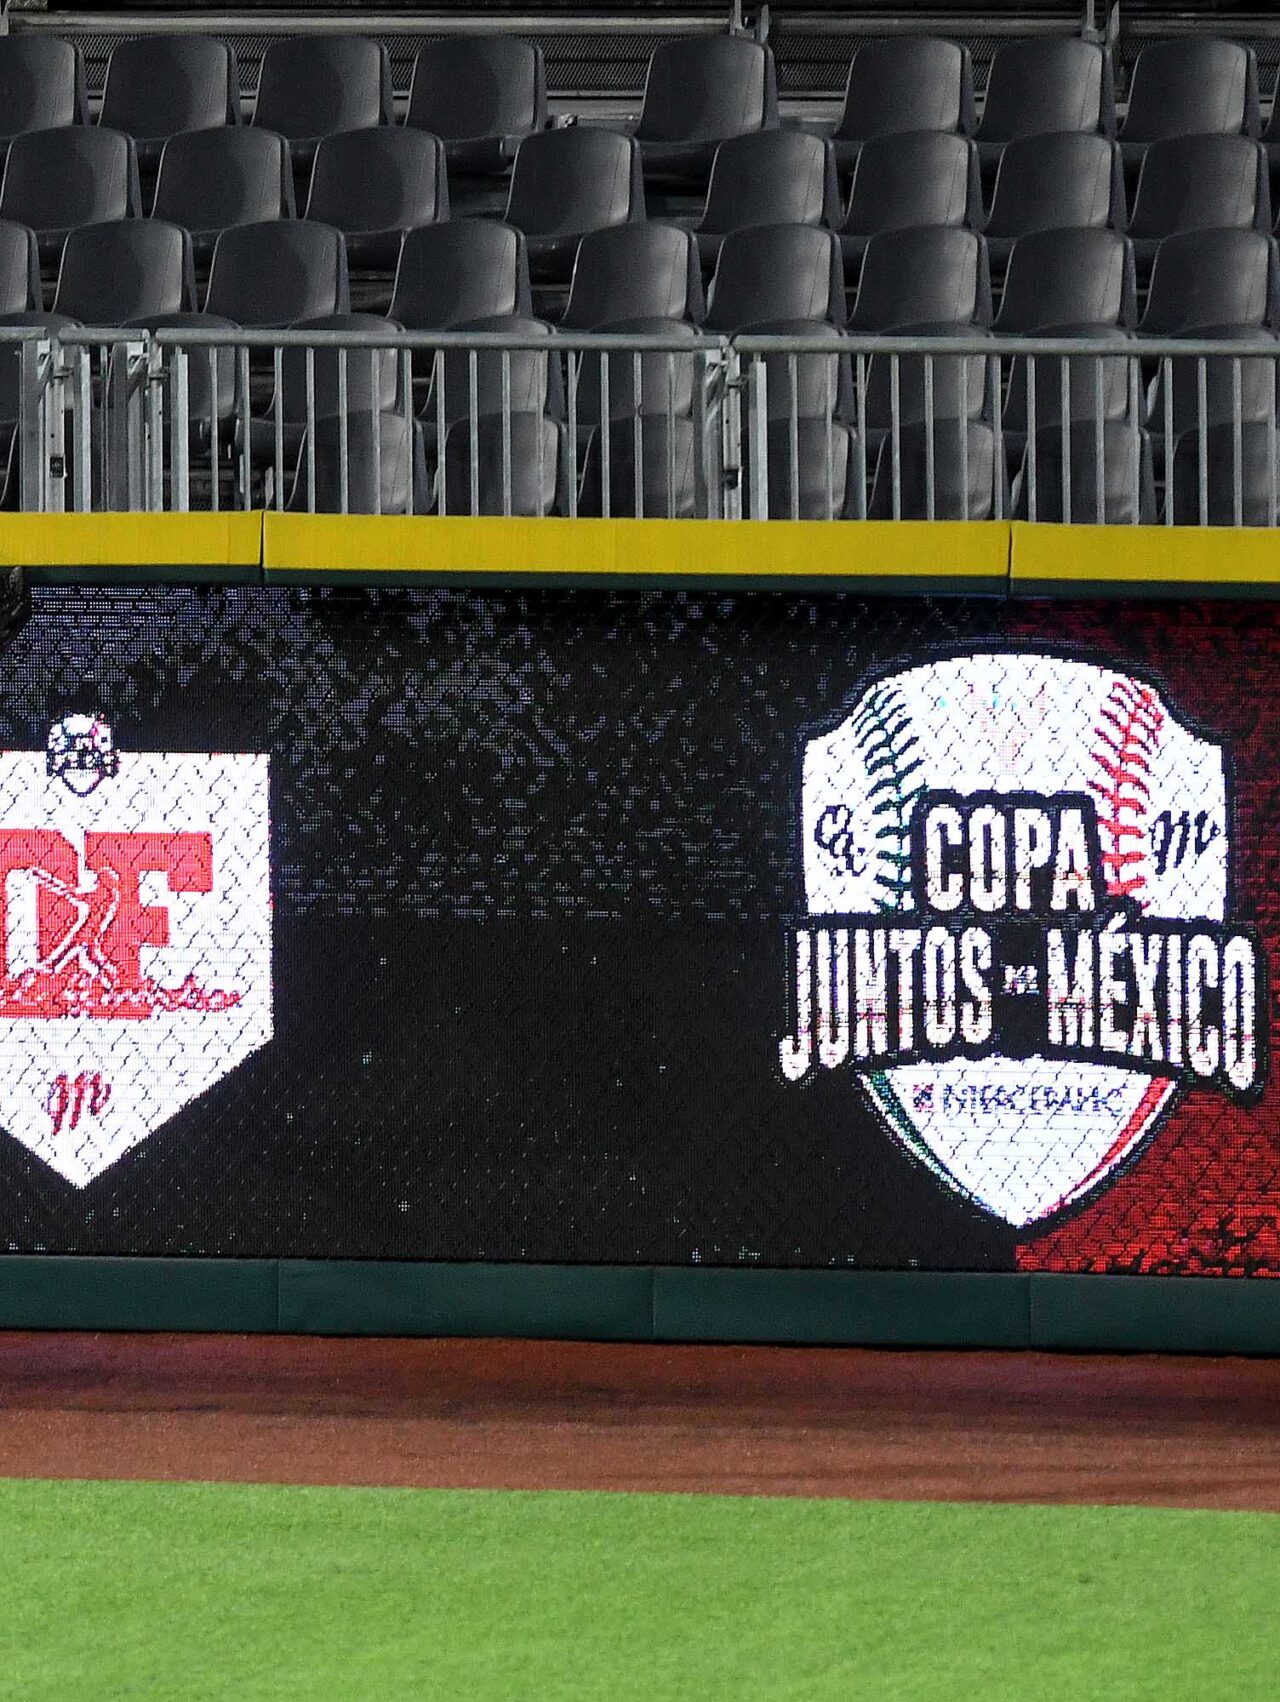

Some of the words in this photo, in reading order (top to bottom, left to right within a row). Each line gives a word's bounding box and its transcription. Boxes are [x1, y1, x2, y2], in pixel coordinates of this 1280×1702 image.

[924, 802, 1096, 912] COPA
[778, 925, 994, 1082] JUNTOS
[1046, 911, 1257, 1091] MÉXICO
